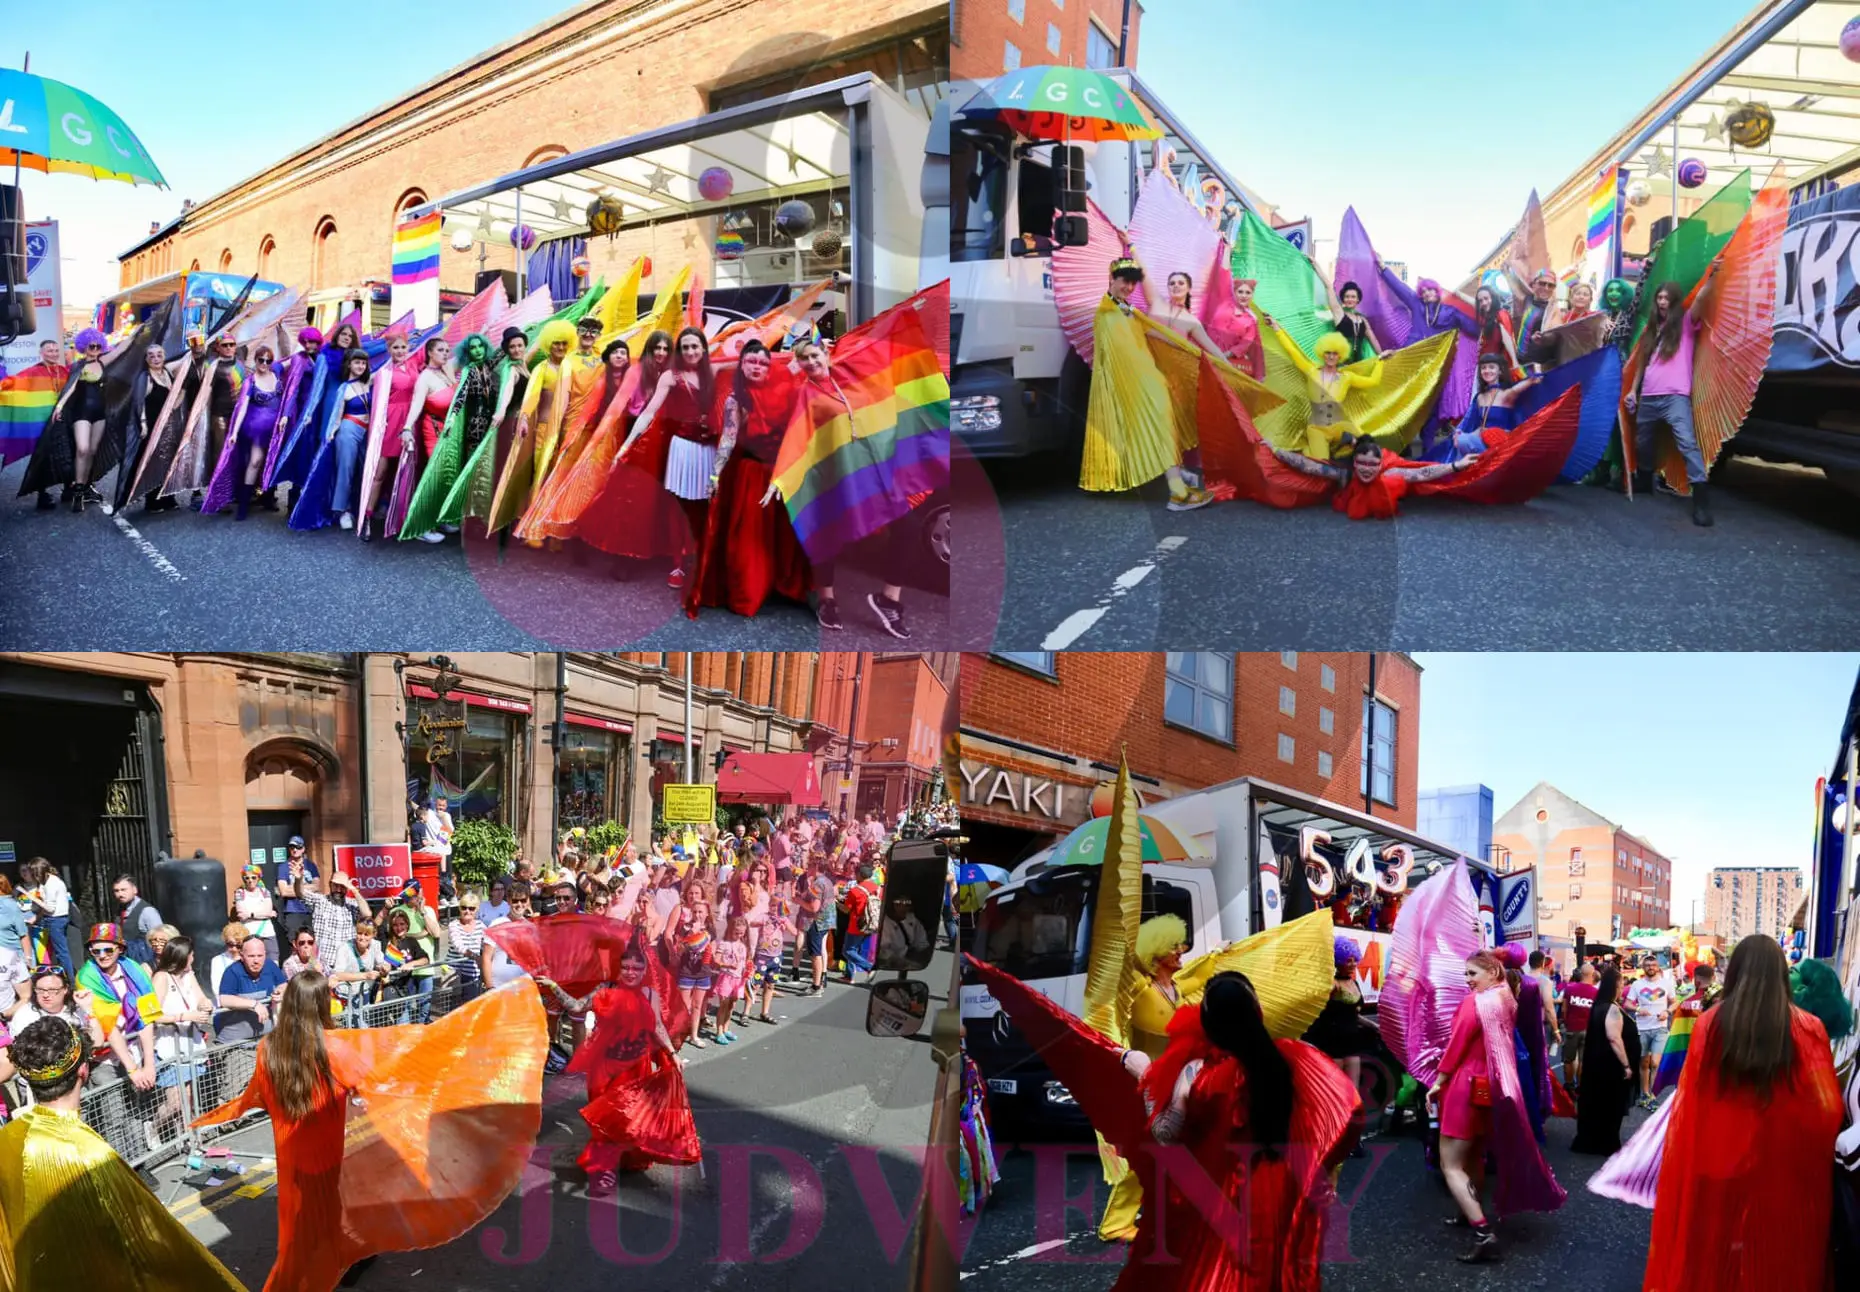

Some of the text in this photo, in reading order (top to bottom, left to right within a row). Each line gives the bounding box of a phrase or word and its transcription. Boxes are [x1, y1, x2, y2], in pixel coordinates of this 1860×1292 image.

[960, 761, 1063, 818] YAKI
[354, 855, 393, 868] ROAD
[350, 875, 403, 890] CLOSED
[1503, 881, 1528, 921] COUNTY
